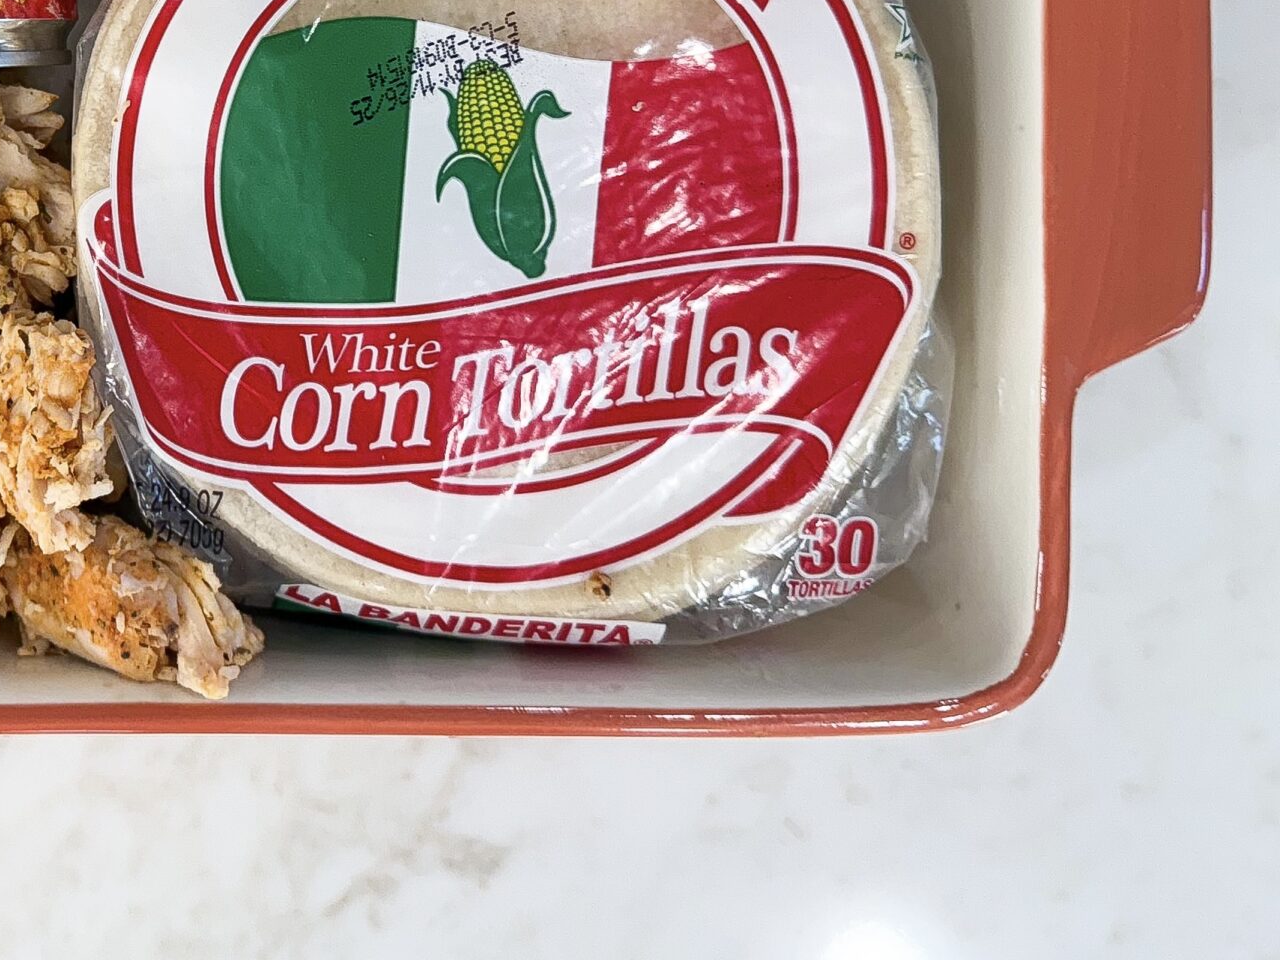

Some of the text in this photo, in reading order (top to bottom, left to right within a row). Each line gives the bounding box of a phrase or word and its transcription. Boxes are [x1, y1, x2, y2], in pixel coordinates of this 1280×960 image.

[217, 297, 800, 456] Corn Tortillas
[301, 330, 442, 377] White
[196, 489, 224, 521] OZ
[796, 515, 877, 577] 30
[284, 585, 635, 646] LA BANDERITA
[787, 578, 874, 599] TORTILLAS
